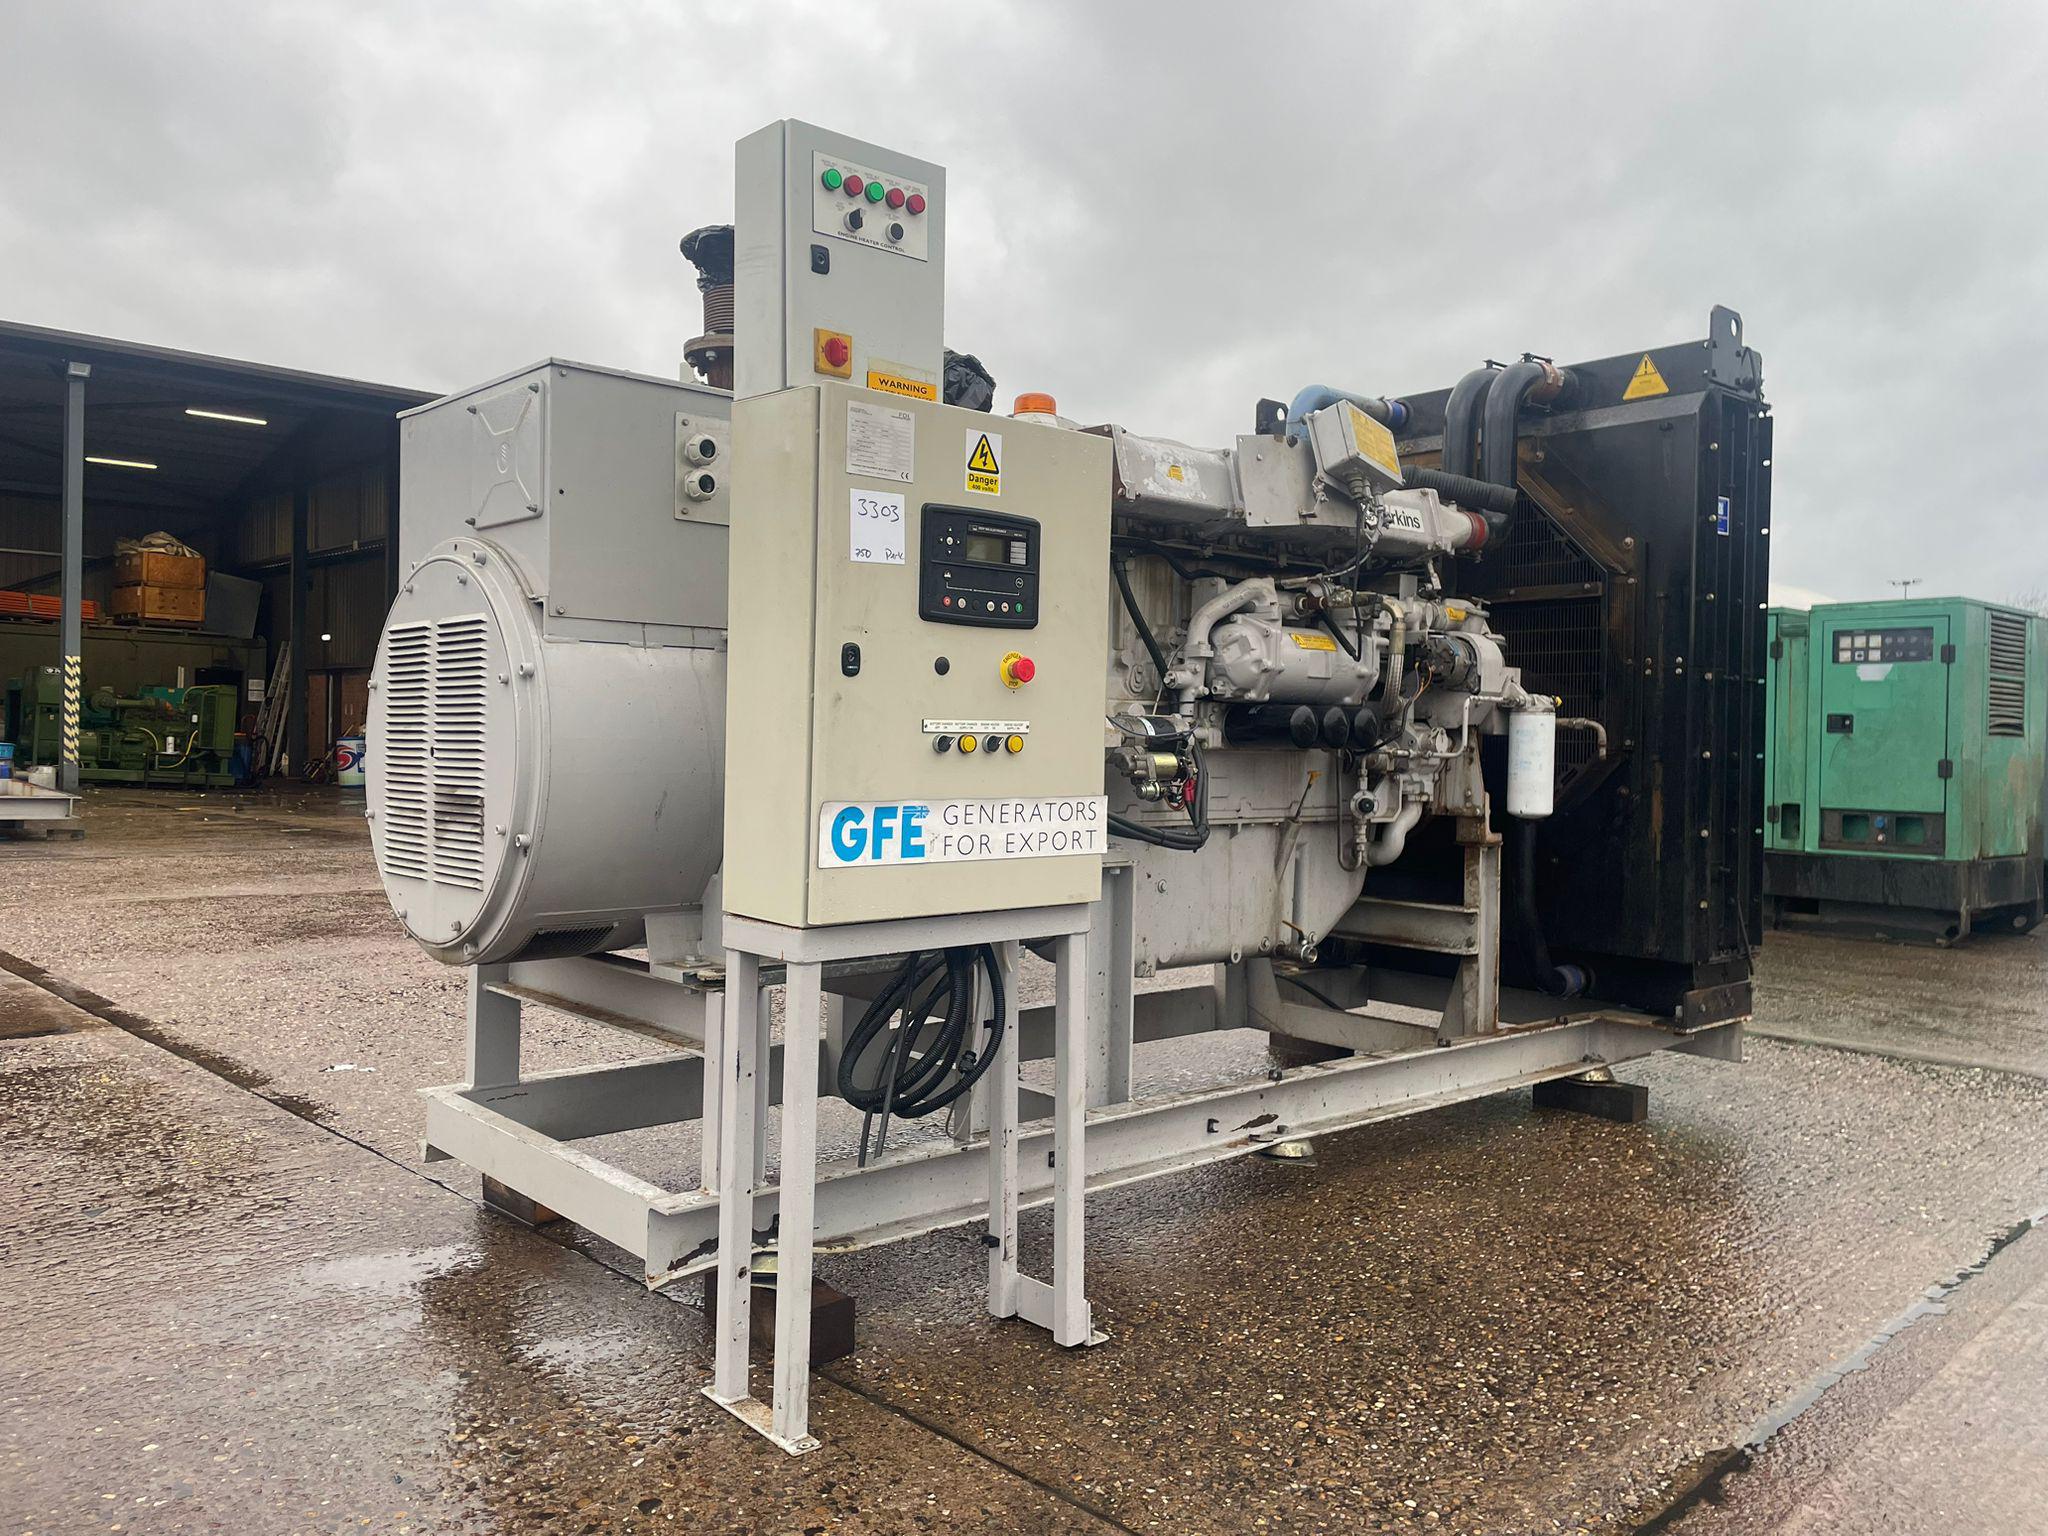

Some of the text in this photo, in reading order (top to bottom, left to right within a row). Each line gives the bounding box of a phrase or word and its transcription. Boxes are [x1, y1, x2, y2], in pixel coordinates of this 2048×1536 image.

[837, 230, 905, 253] ENGINE HEATER CONTROL
[878, 377, 928, 395] WARNING
[968, 473, 998, 486] Danger
[857, 498, 900, 523] 3303
[943, 801, 1098, 826] GENERATORS
[831, 804, 926, 862] GFE
[943, 829, 1097, 857] FOR EXPORT
